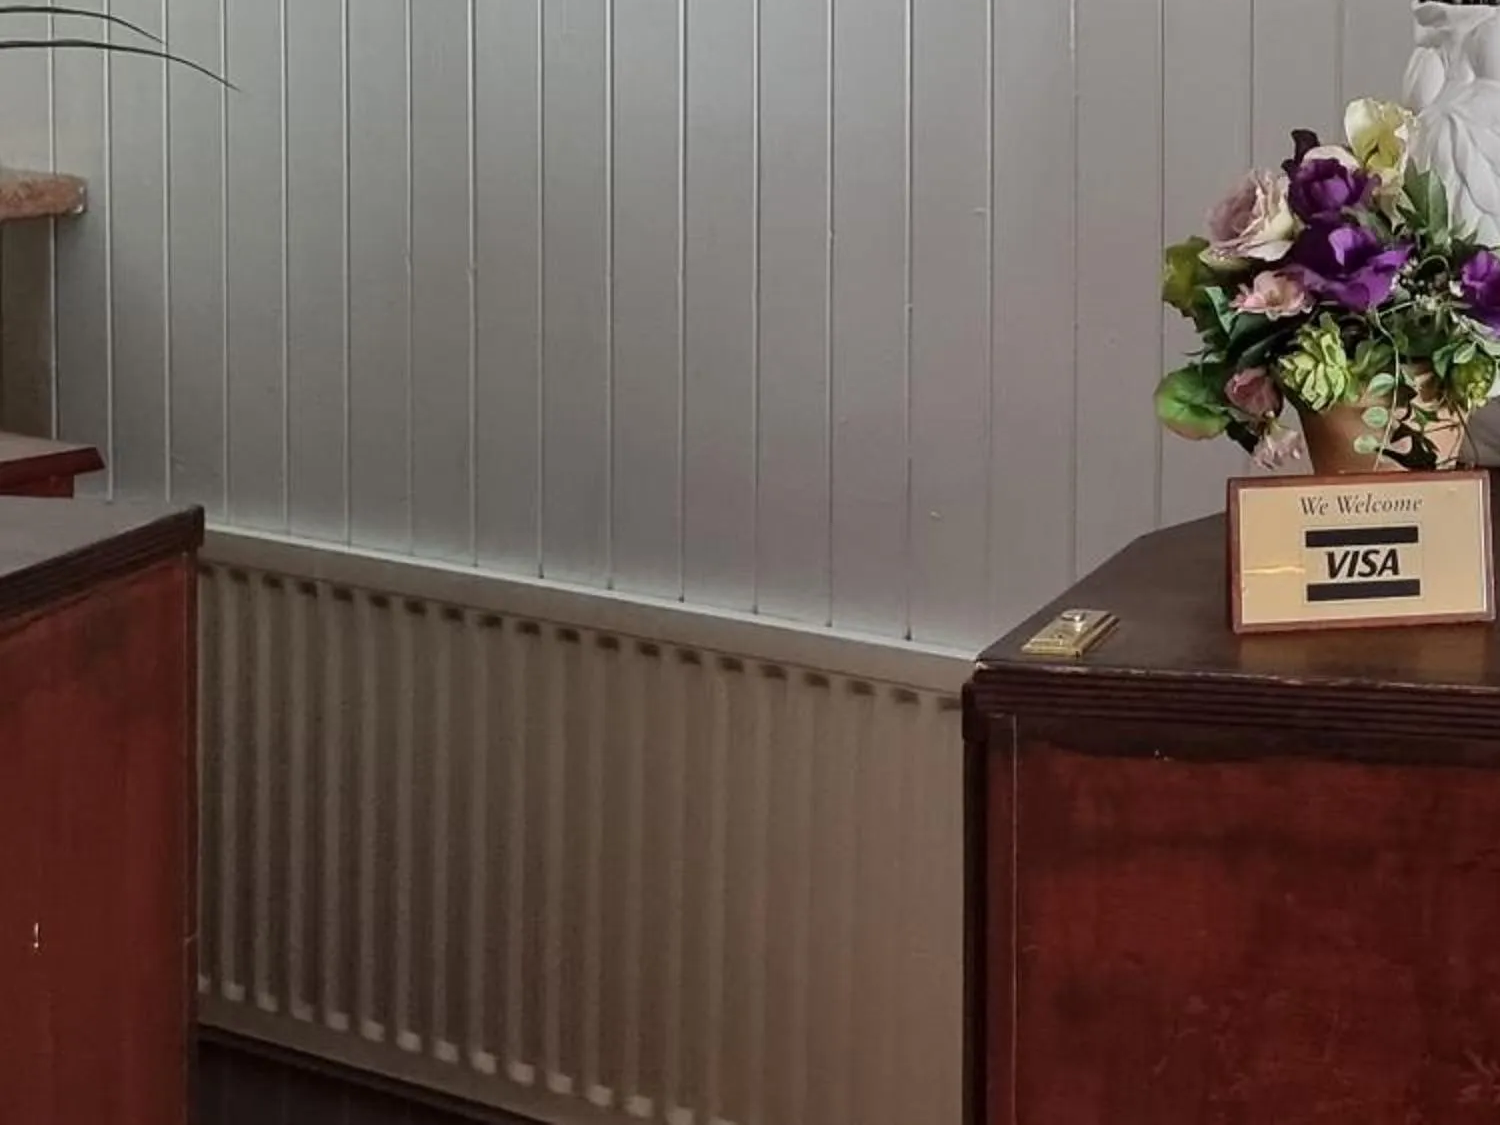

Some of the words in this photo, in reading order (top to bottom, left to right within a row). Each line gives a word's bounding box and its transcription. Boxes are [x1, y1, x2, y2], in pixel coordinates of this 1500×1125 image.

[1298, 495, 1329, 516] We
[1336, 492, 1423, 515] Welcome
[1325, 548, 1400, 580] VISA
